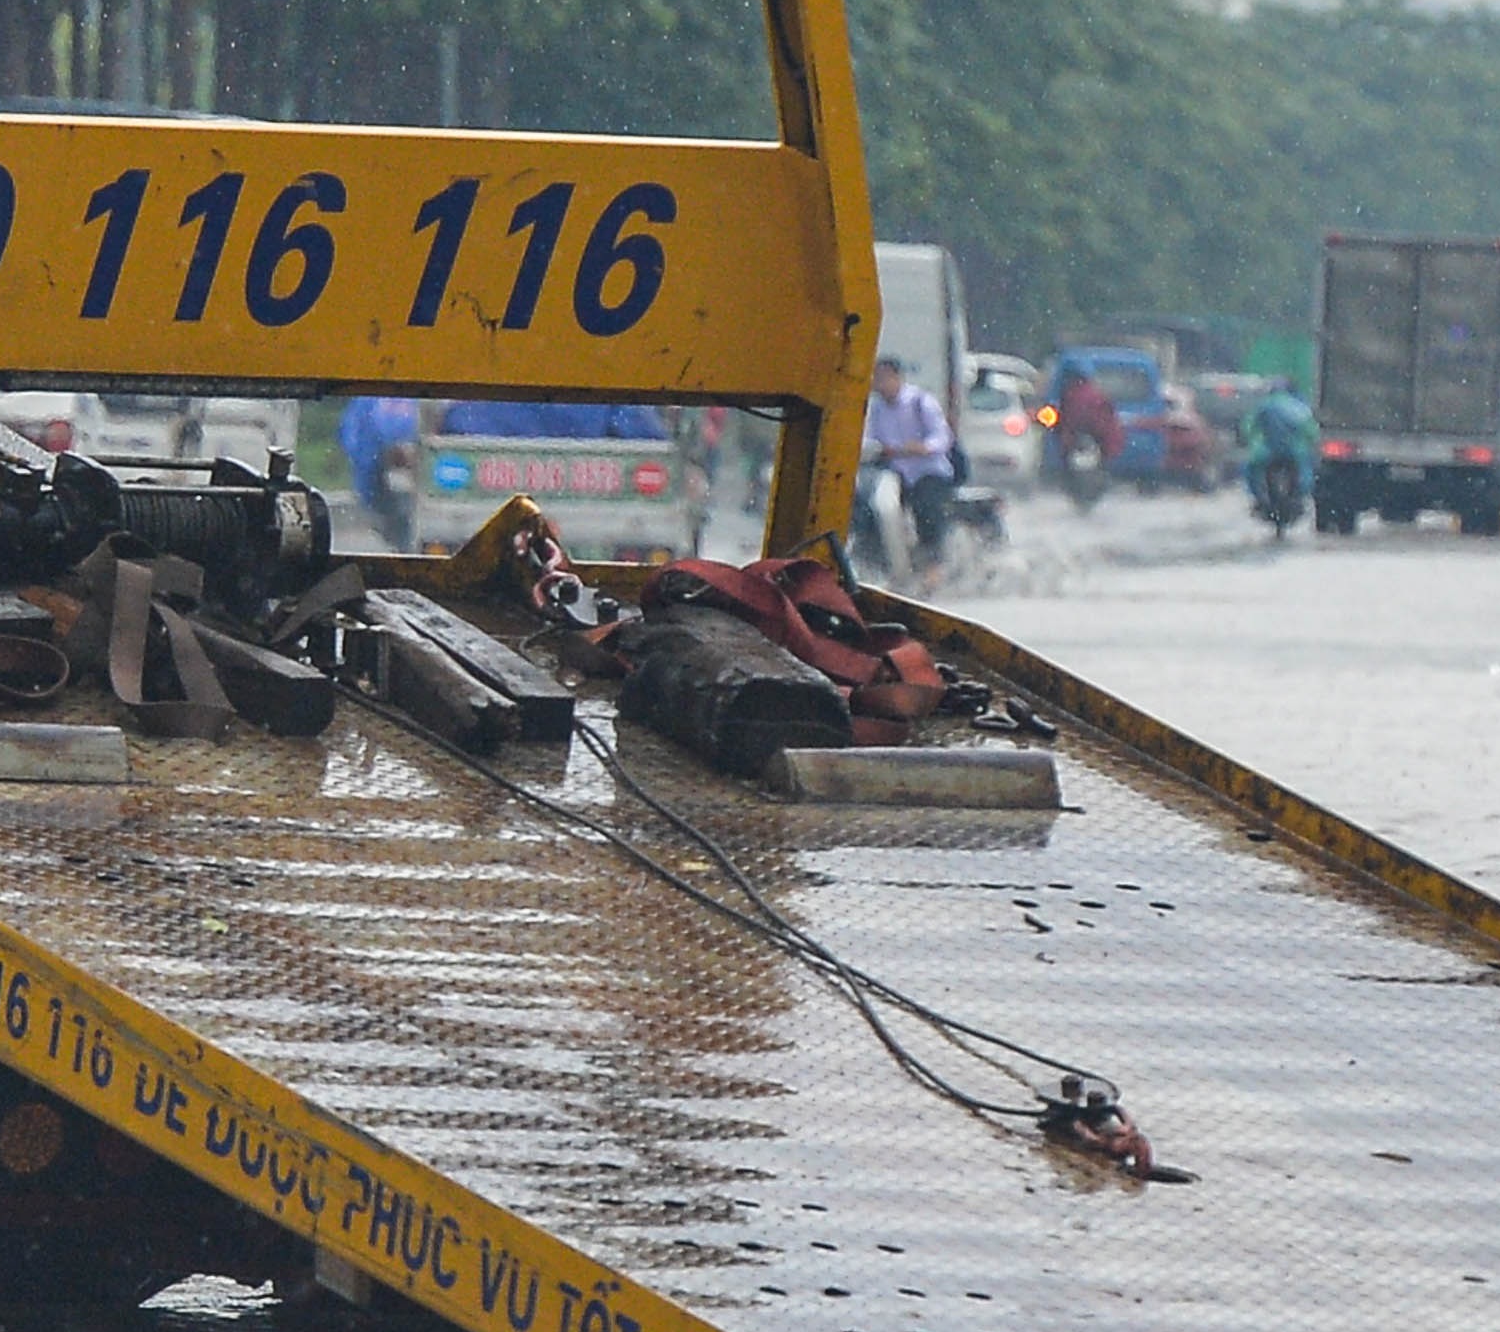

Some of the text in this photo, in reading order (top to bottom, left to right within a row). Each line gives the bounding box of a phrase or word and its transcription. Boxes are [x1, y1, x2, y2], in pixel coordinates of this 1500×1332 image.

[80, 168, 347, 327] 116
[407, 177, 678, 337] 116
[46, 996, 114, 1088] 116
[340, 1161, 462, 1289] PHỤC
